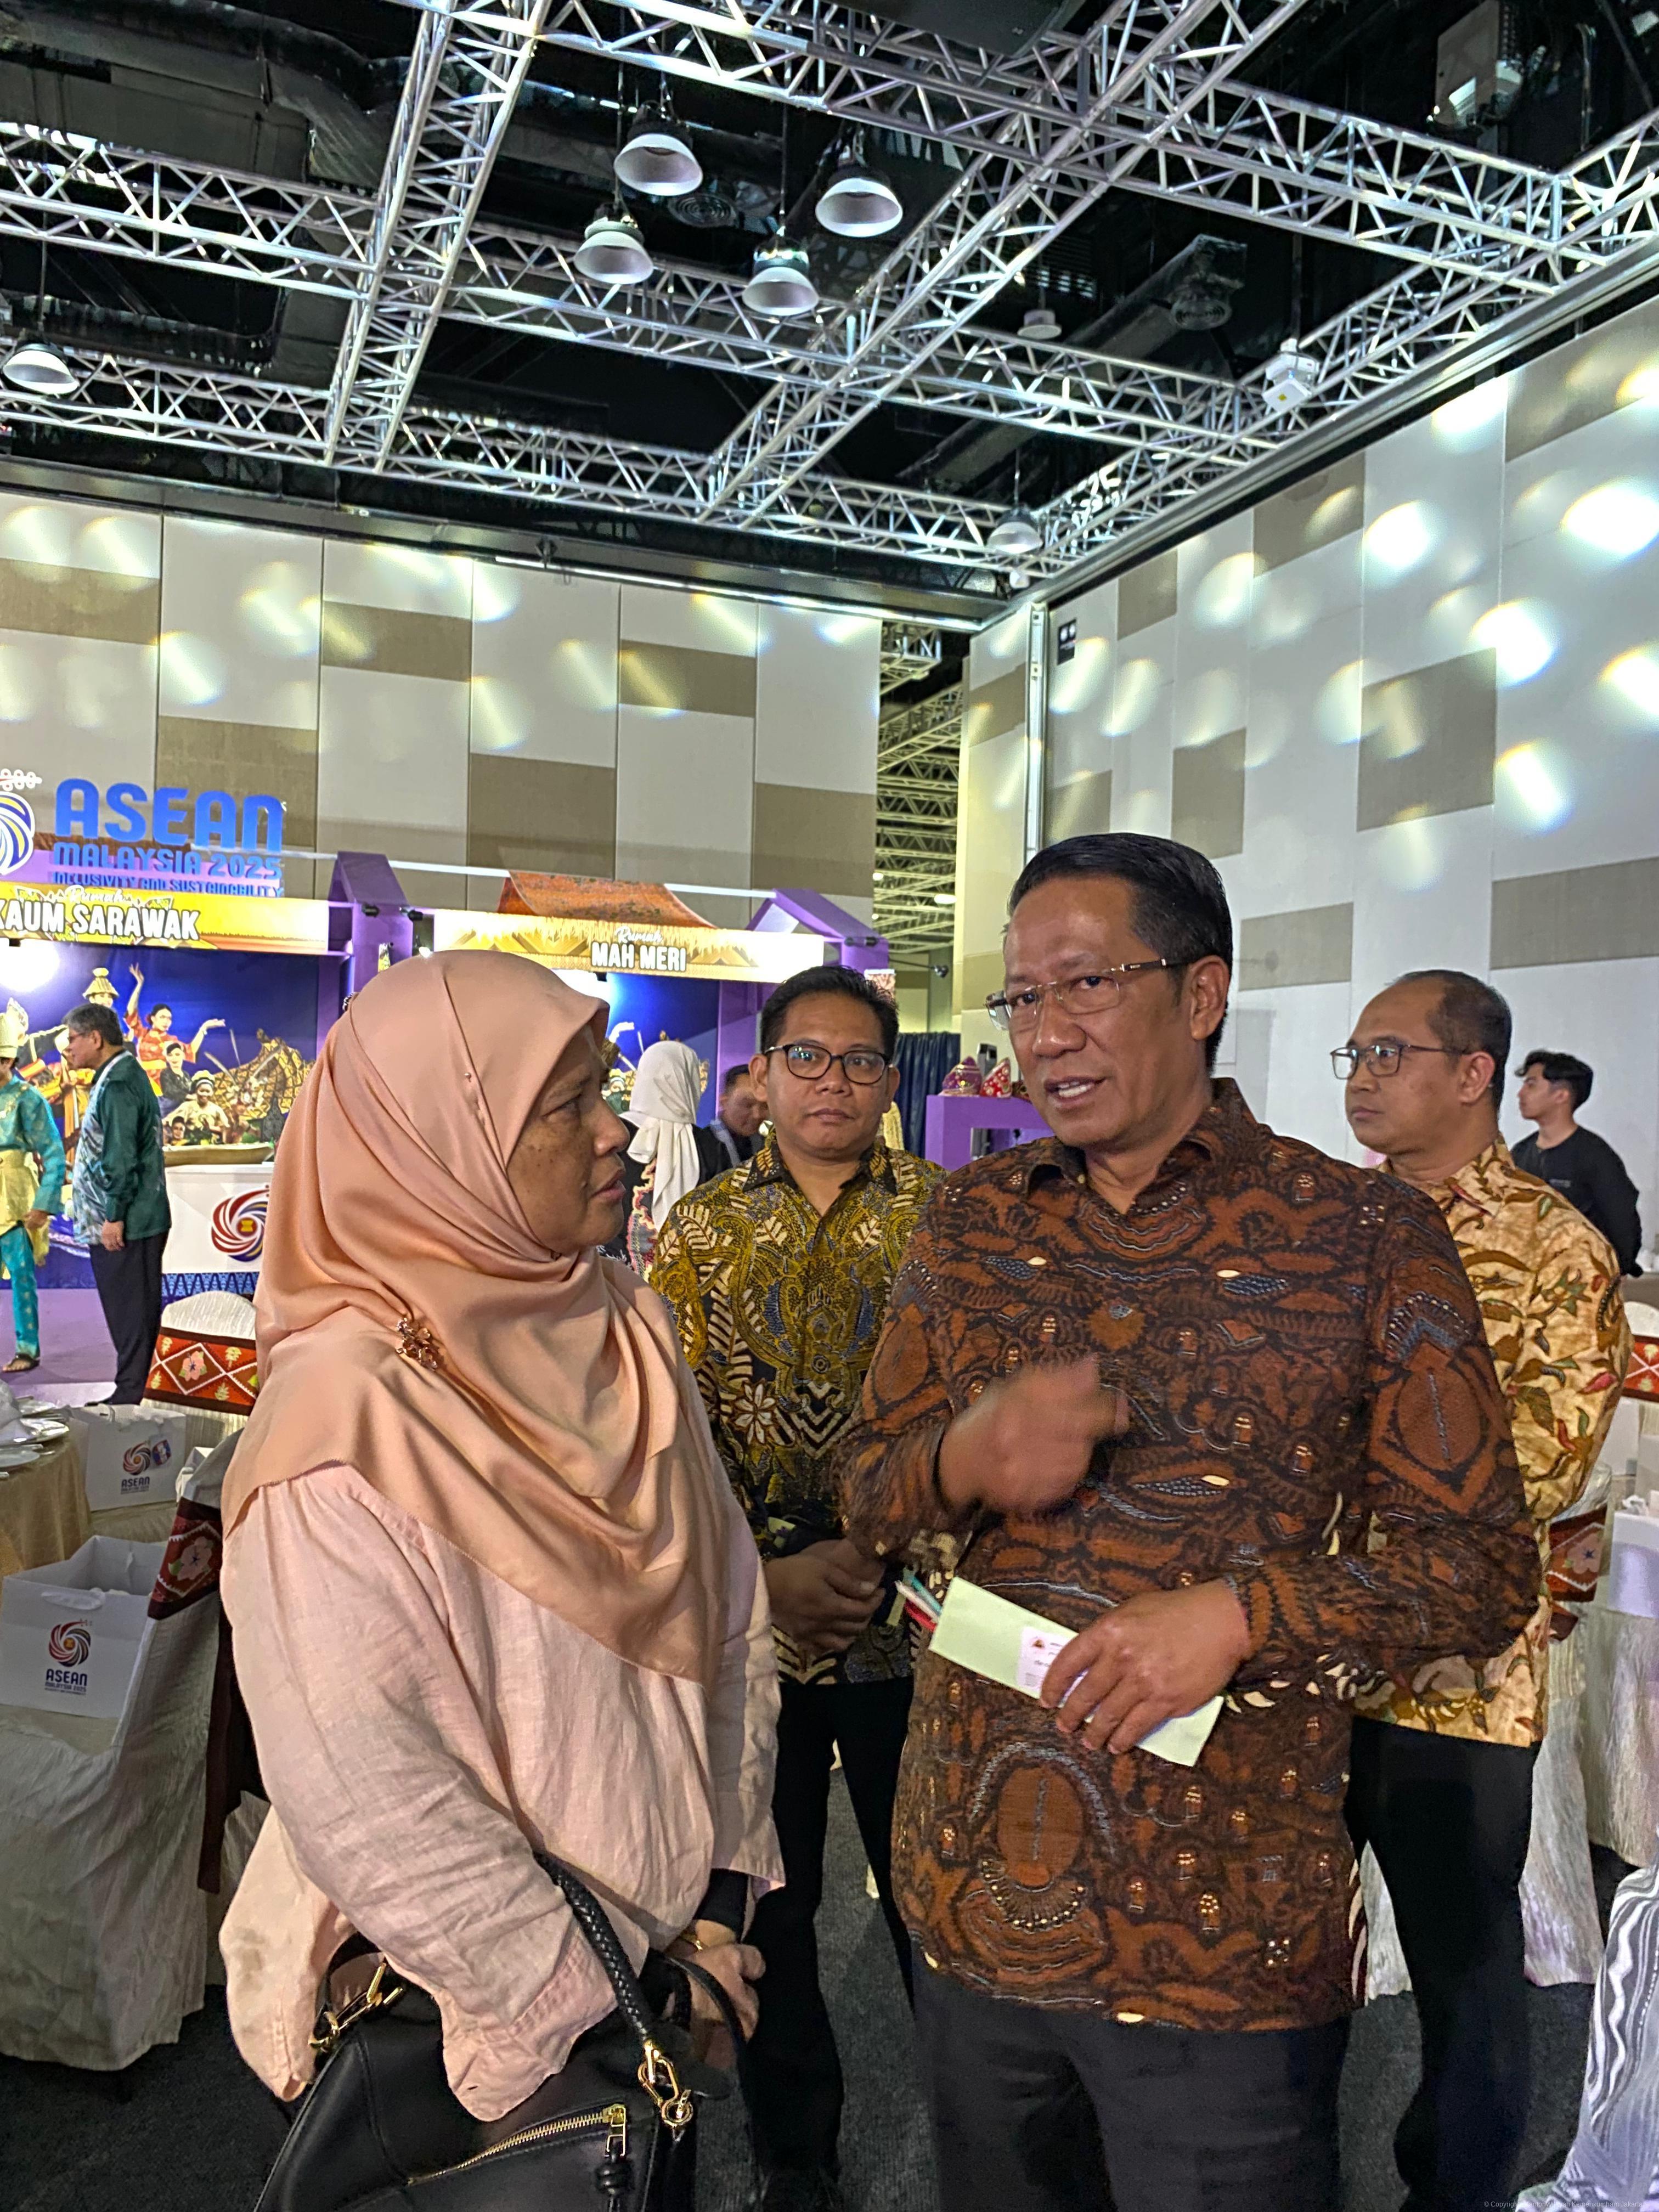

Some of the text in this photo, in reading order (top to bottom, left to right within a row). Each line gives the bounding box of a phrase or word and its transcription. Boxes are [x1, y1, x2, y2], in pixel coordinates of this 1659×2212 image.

[55, 778, 283, 854] ASEAN
[53, 842, 283, 879] MALAYSIA 2025
[53, 872, 284, 898] INCLUSIVITY AND SUSTAINABILITY
[65, 885, 126, 904] Rumah
[72, 905, 200, 940] SARAWAK
[615, 926, 663, 944] Rumah
[591, 941, 686, 972] MAH MERI
[121, 1476, 150, 1488] ASEAN
[46, 1668, 87, 1686] ASEAN
